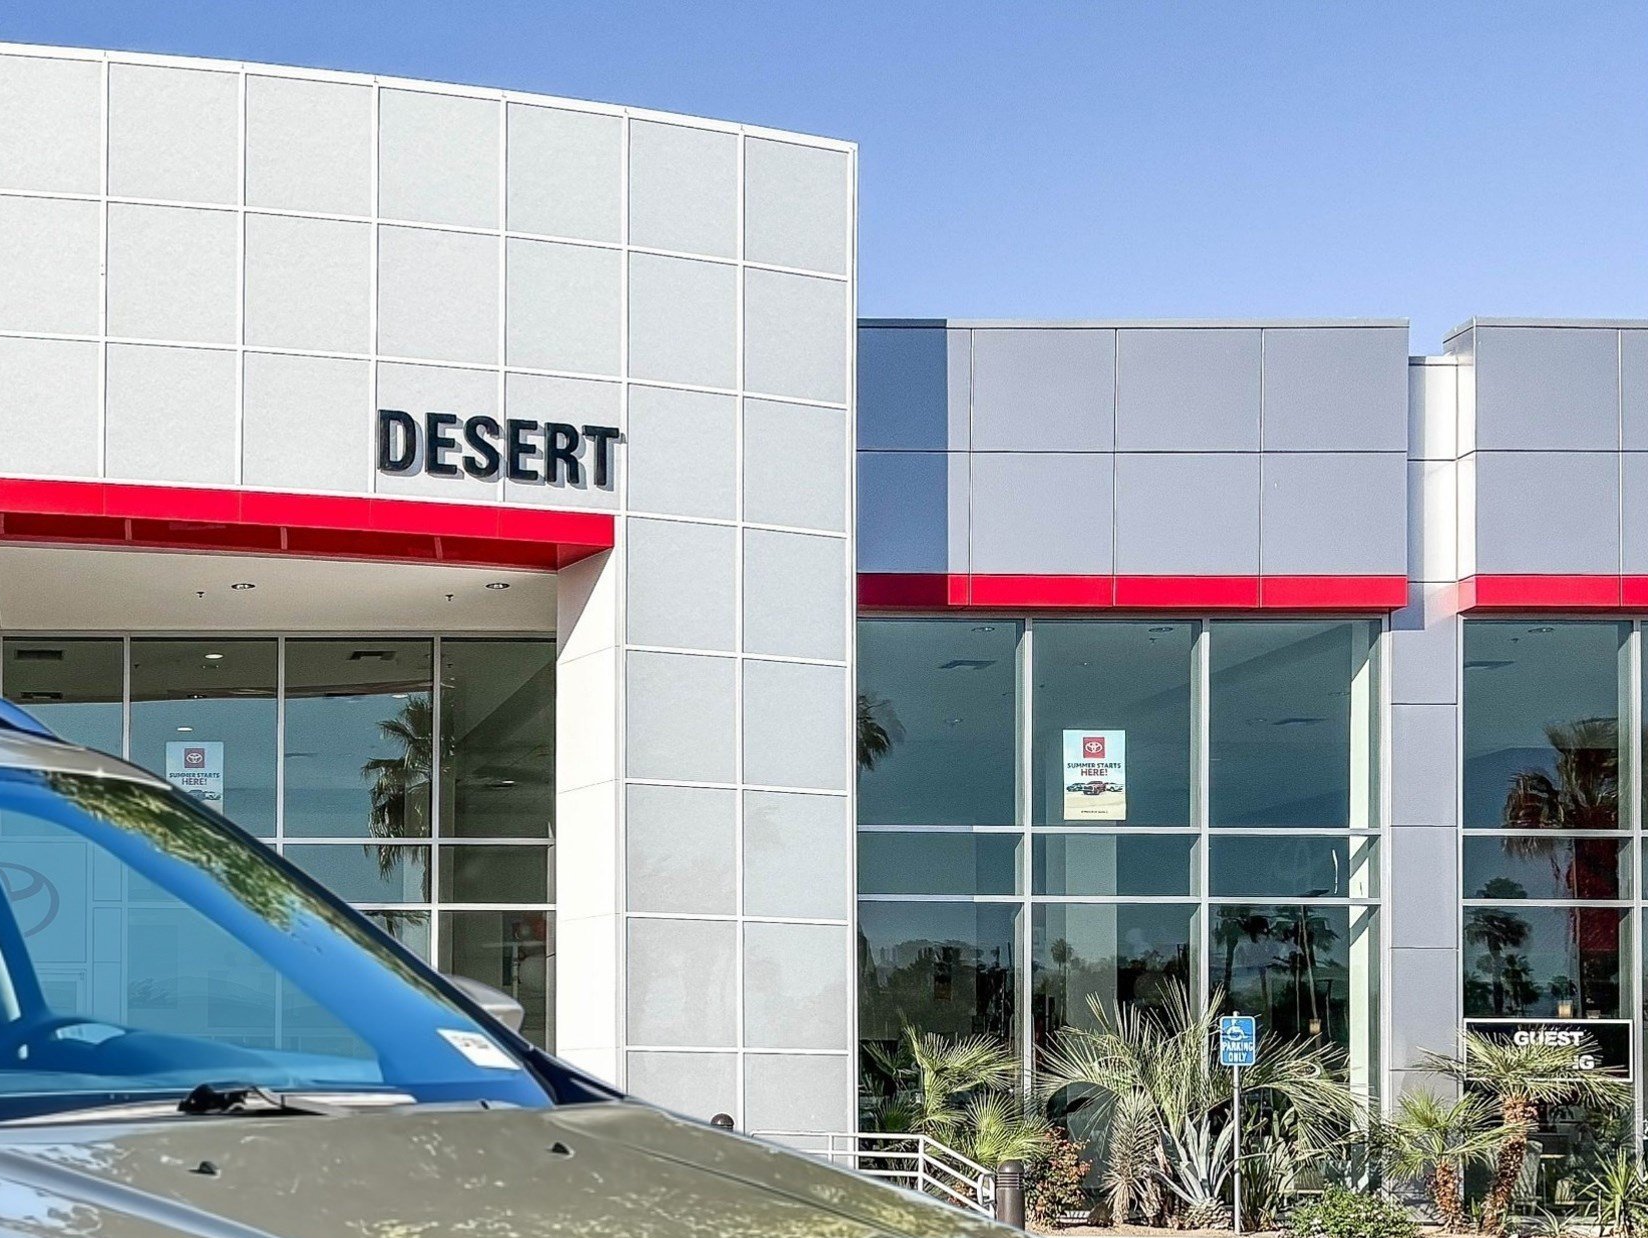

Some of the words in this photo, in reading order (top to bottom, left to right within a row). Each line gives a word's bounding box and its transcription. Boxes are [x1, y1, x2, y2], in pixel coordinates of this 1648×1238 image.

[377, 409, 620, 486] DESERT
[181, 778, 207, 786] HERE!
[1513, 1030, 1584, 1047] GUEST
[1222, 1041, 1253, 1052] PARKING
[1228, 1053, 1247, 1062] ONLY
